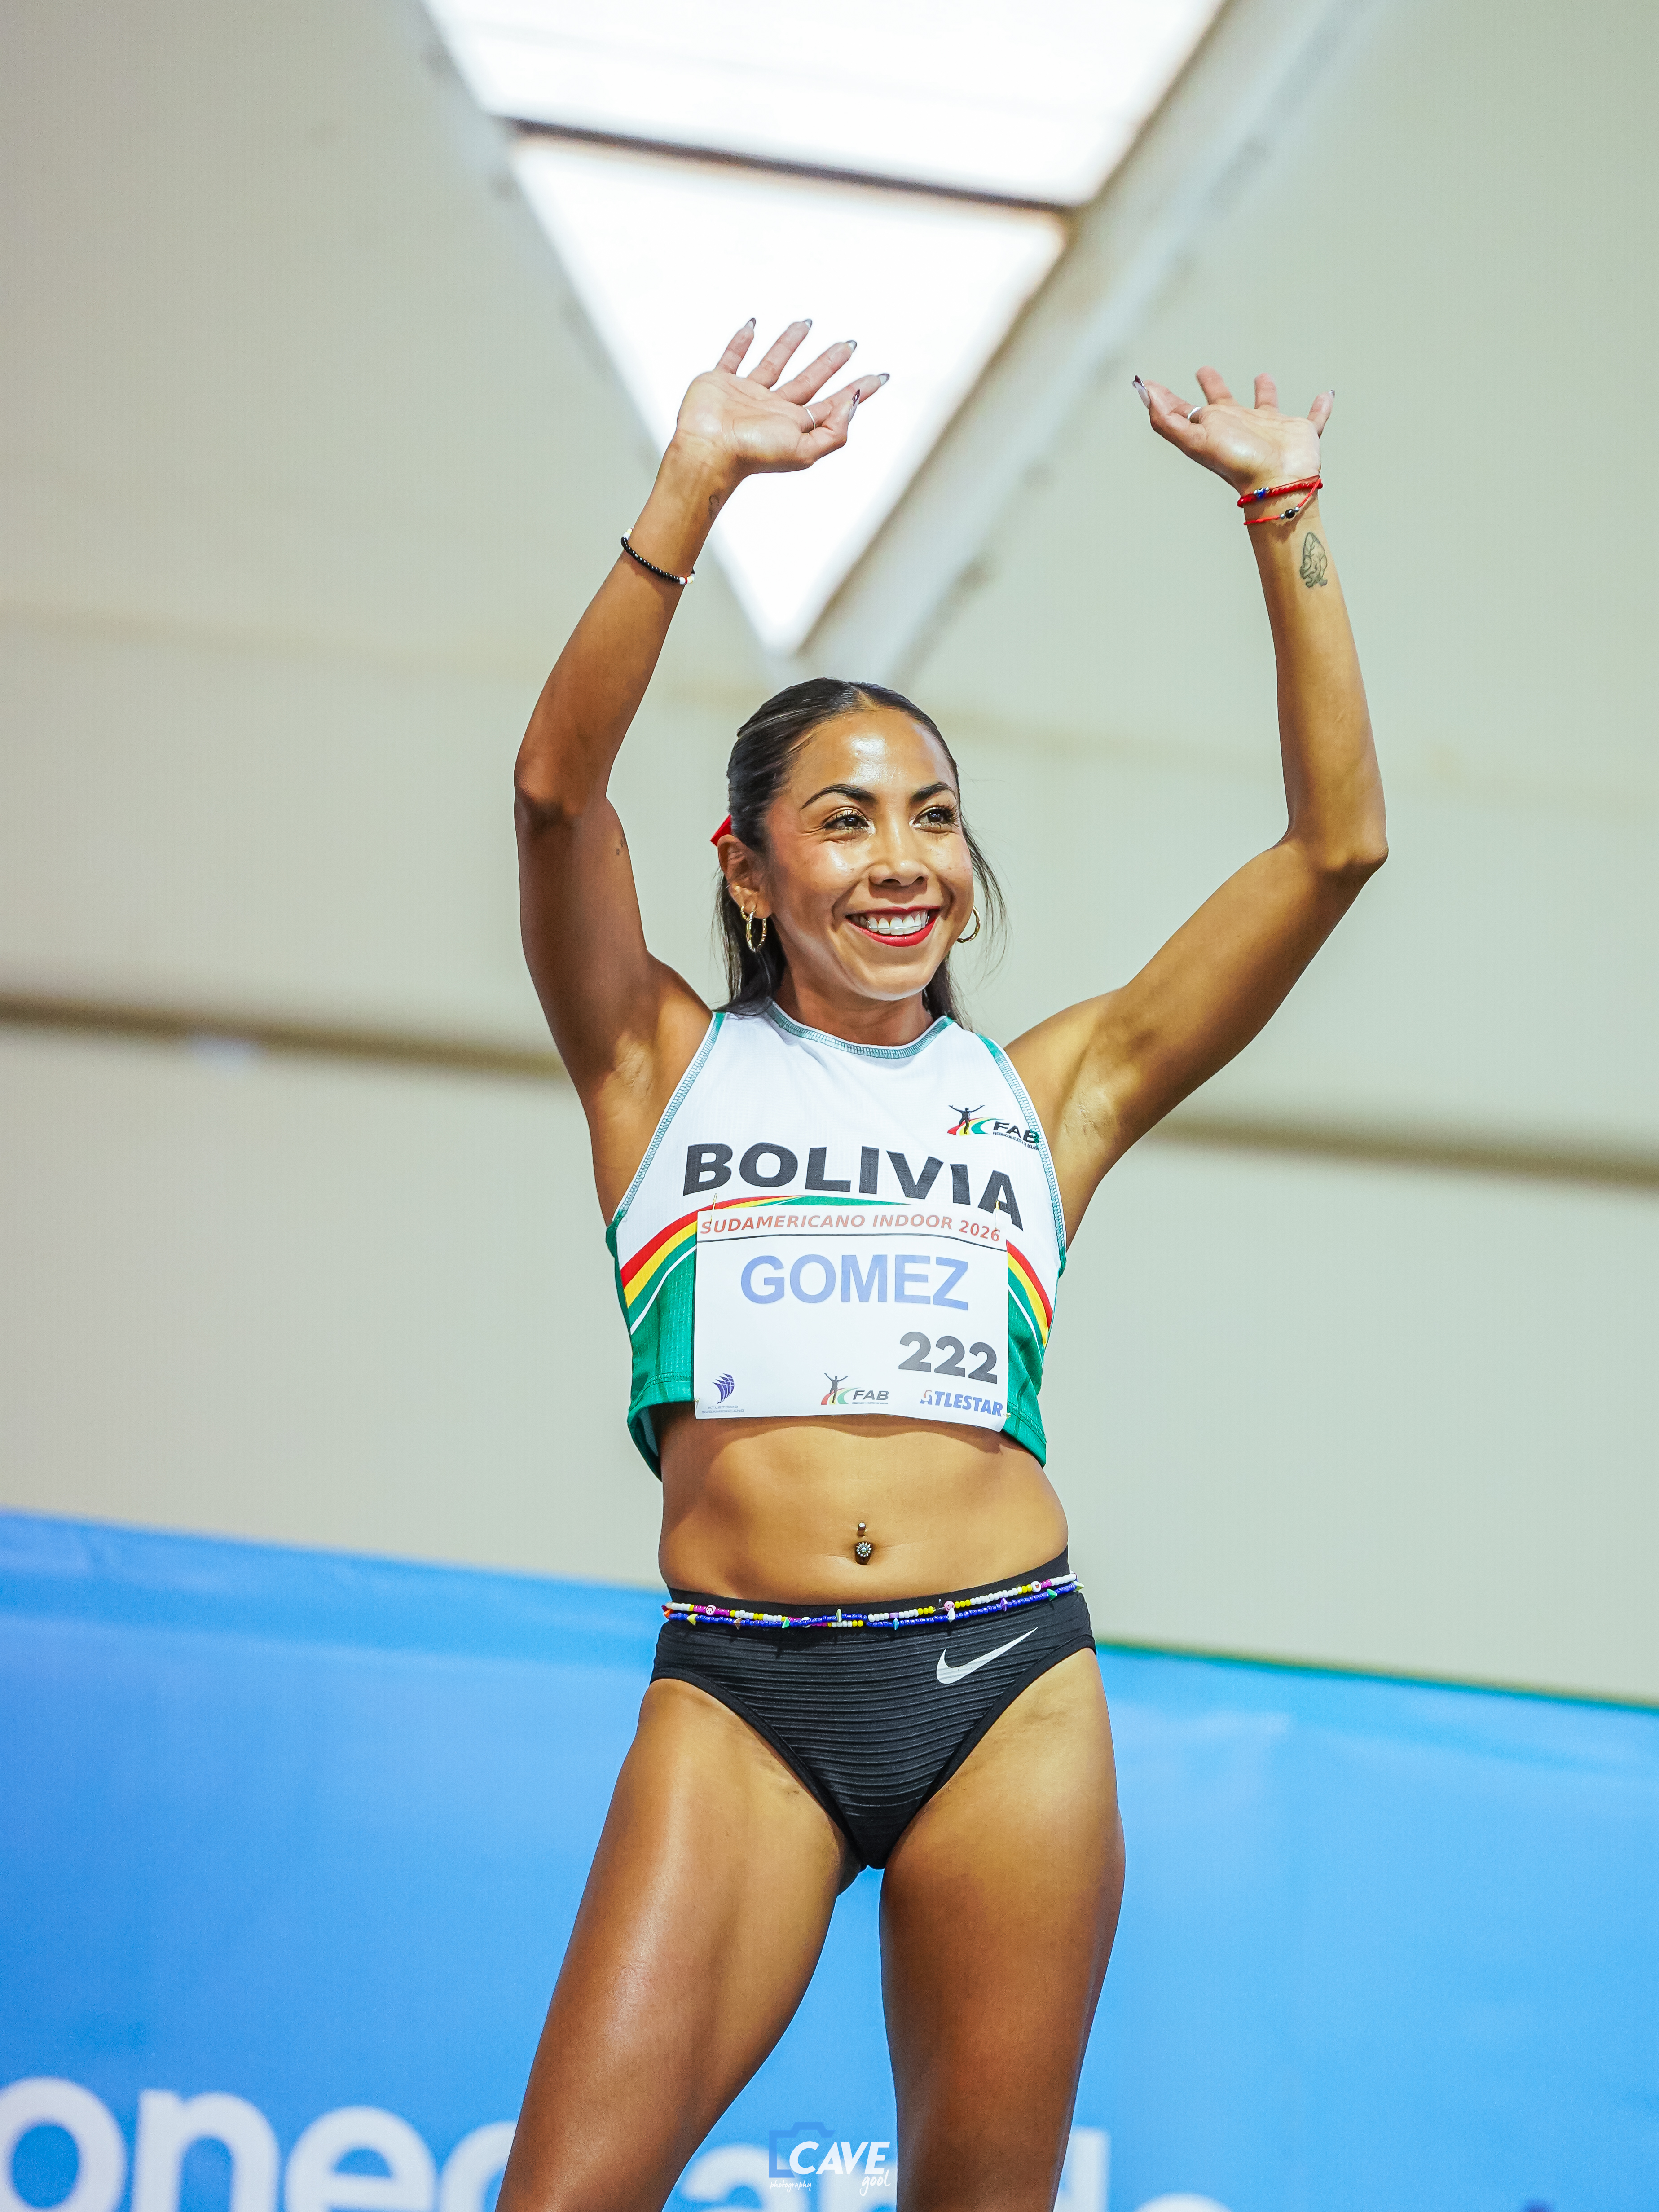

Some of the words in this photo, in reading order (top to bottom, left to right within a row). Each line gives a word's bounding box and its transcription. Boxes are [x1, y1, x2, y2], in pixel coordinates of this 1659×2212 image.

[993, 1121, 1039, 1143] FAB
[683, 1142, 1023, 1231] BOLIVIA
[700, 1214, 865, 1234] SUDAMERICANO
[872, 1214, 952, 1230] INDOOR
[959, 1220, 1001, 1242] 2026
[740, 1254, 968, 1311] GOMEZ
[898, 1331, 998, 1384] 222
[853, 1390, 889, 1400] FAB
[920, 1390, 1003, 1417] ATLESTAR
